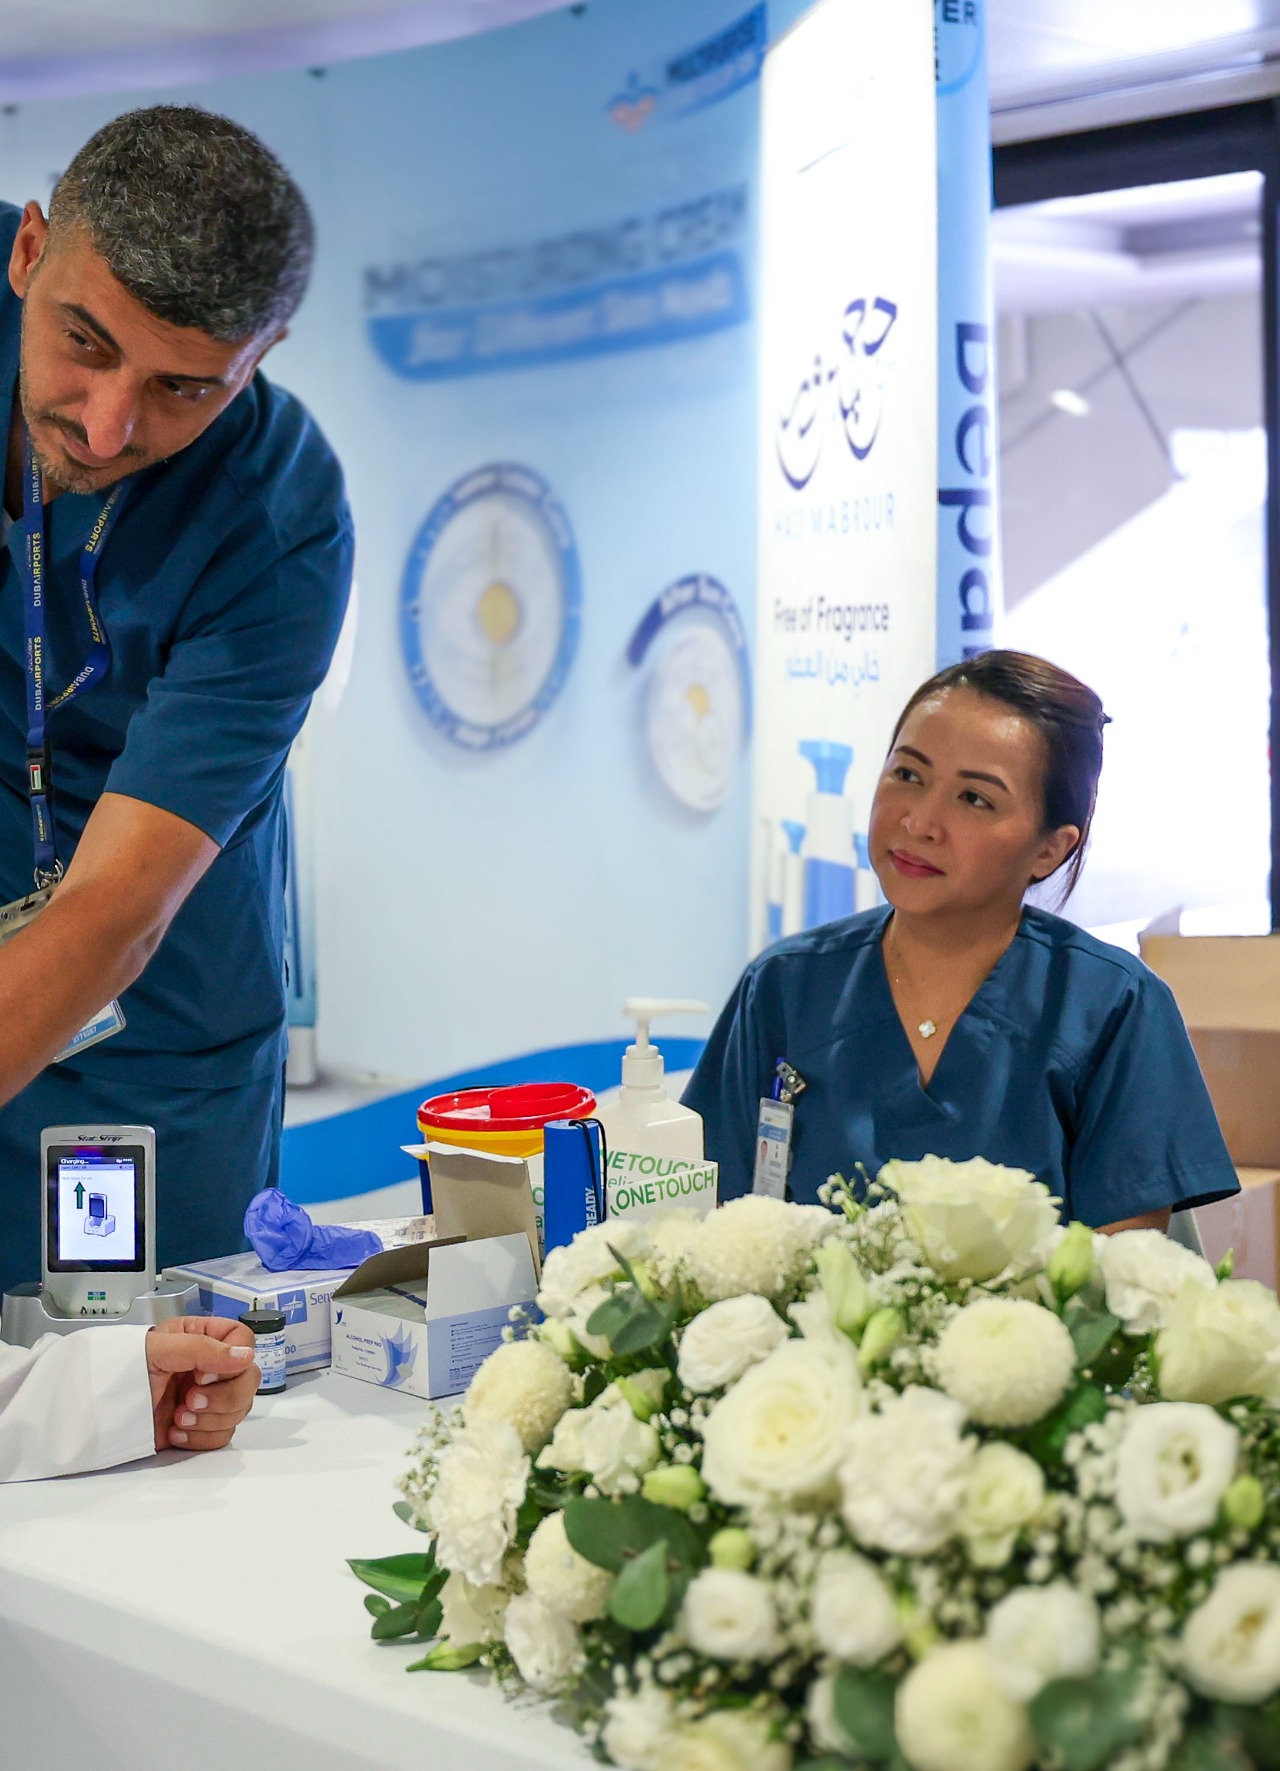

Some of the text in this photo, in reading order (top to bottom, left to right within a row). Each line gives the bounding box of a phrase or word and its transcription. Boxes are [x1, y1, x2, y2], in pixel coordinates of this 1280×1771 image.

[32, 532, 41, 607] DUBAIRPORTS
[818, 595, 890, 643] Fragrance
[34, 636, 42, 711] DUBAIRPORTS
[45, 666, 95, 709] DUBAIRPORT
[600, 1148, 705, 1178] NETOUC
[615, 1168, 715, 1210] ONETOUCH
[285, 1345, 296, 1354] 00
